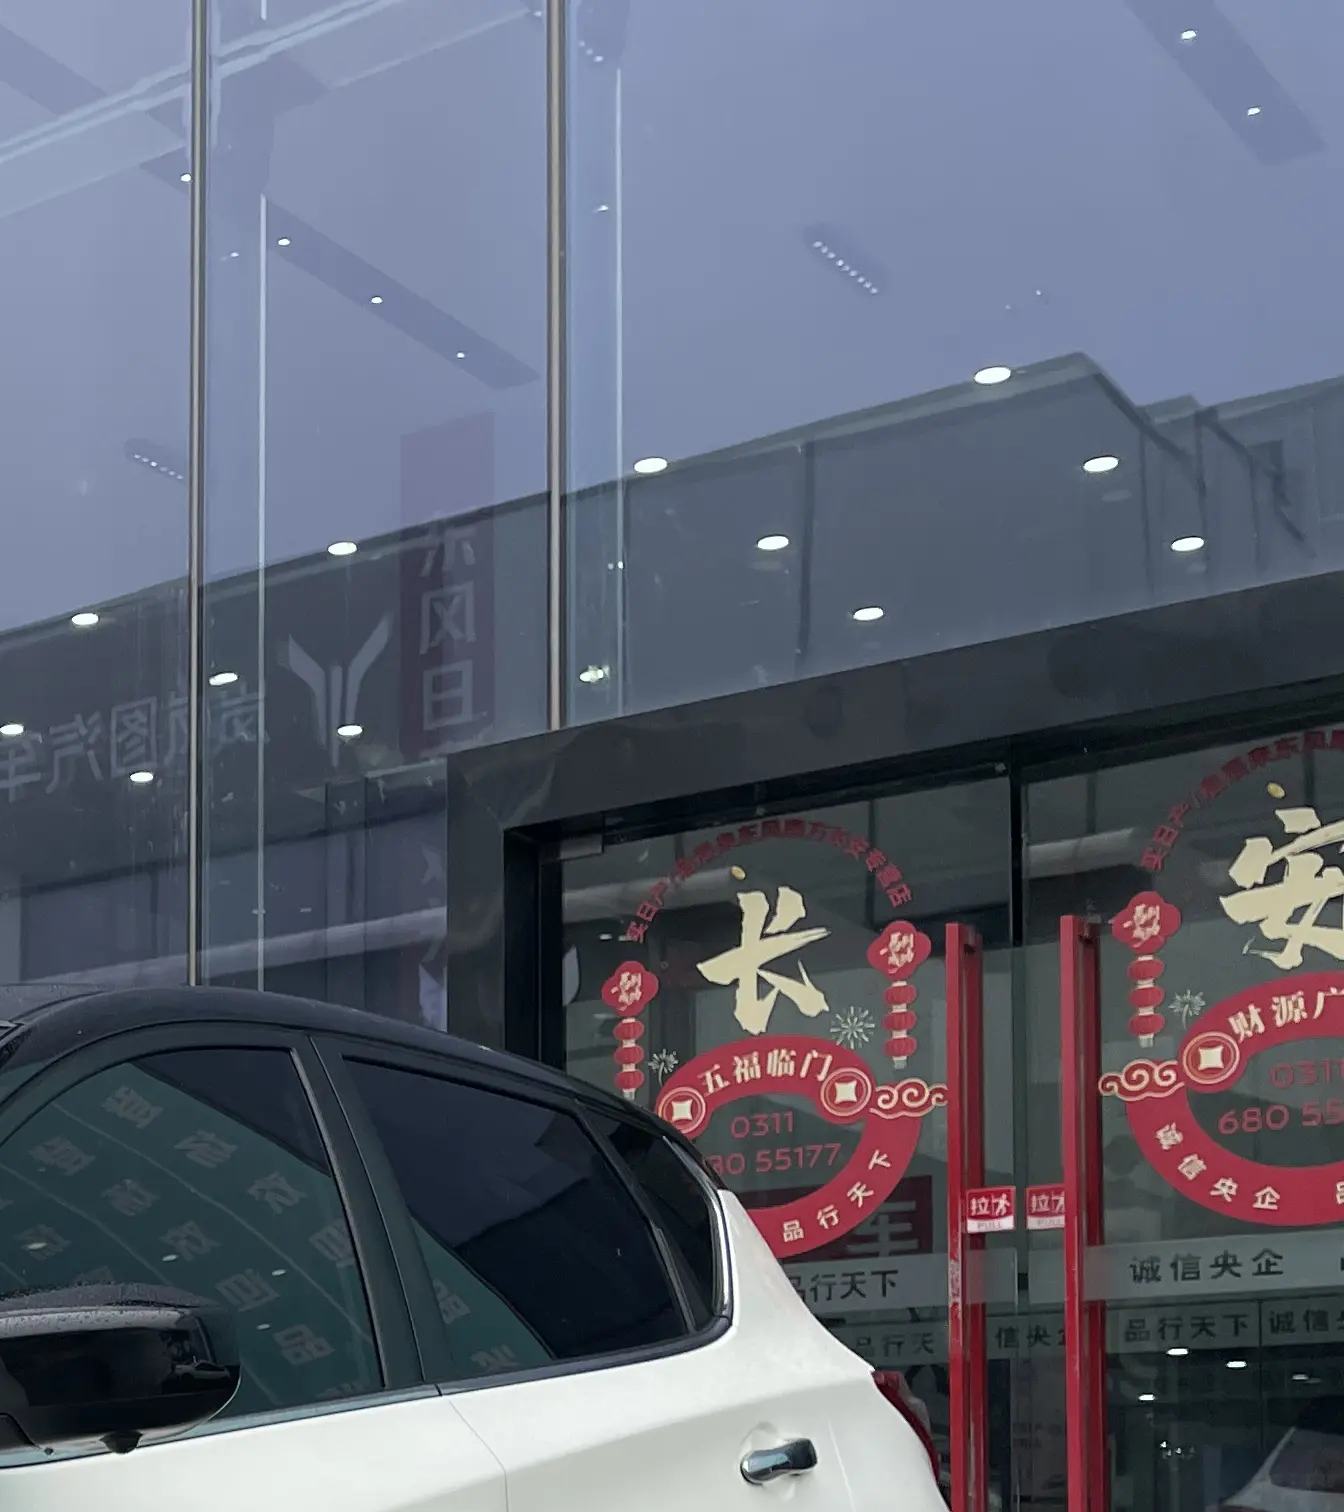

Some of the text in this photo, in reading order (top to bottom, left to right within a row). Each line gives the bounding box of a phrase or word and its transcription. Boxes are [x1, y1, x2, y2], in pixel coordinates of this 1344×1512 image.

[1218, 806, 1344, 969] 安
[696, 885, 832, 1035] 长
[696, 1048, 833, 1098] 五福临门
[730, 1110, 795, 1139] 0311
[1217, 1104, 1290, 1135] 680
[755, 1142, 842, 1173] 55177
[1154, 1122, 1281, 1211] 诚信央企
[782, 1150, 892, 1243] 品行天下
[970, 1196, 990, 1216] 拉
[1031, 1194, 1050, 1213] 拉
[1129, 1247, 1284, 1284] 诚信央企
[1123, 1313, 1249, 1343] 品行天下
